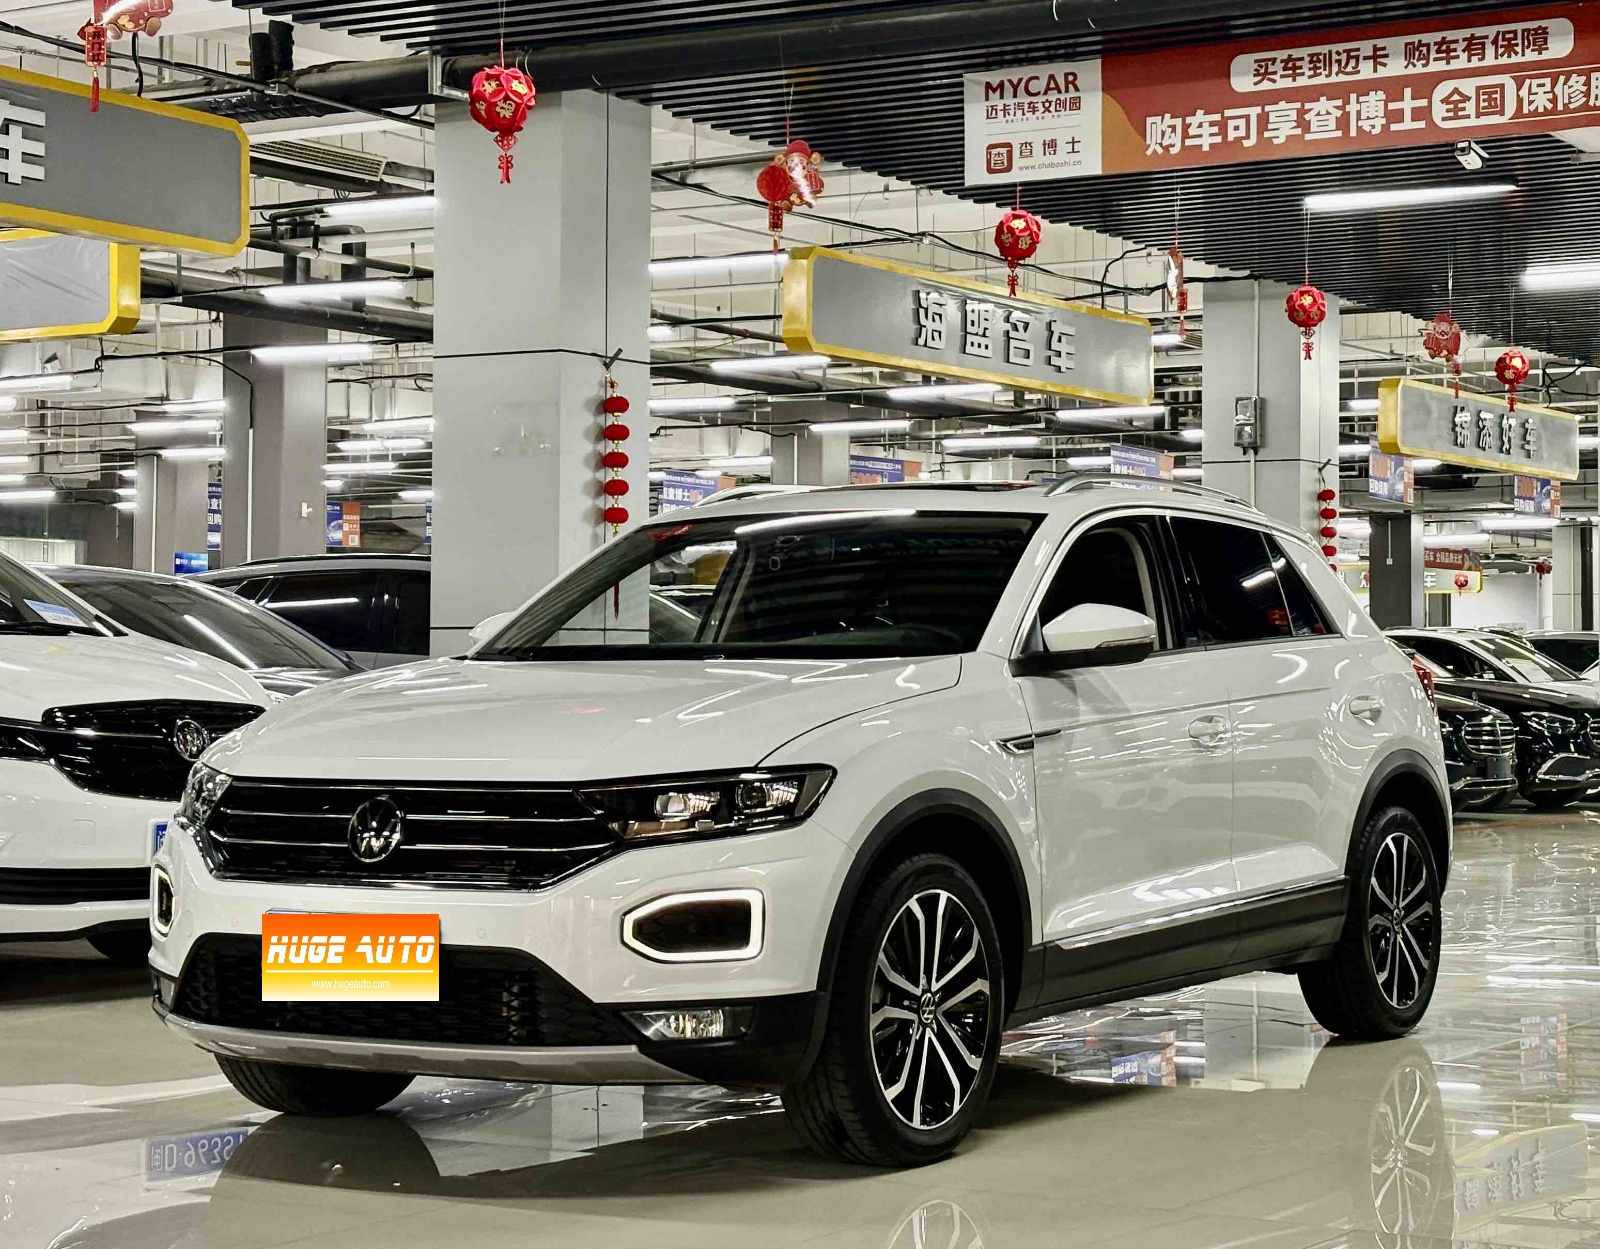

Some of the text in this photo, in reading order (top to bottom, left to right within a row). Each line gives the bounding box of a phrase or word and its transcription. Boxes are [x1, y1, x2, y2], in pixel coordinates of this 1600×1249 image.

[1252, 25, 1549, 86] 买车到迈卡 购车有保障
[984, 72, 1080, 102] MYCAR
[985, 96, 1082, 120] 迈卡汽车文创园
[1018, 137, 1082, 159] 查博士
[917, 288, 1076, 374] 海盟名车
